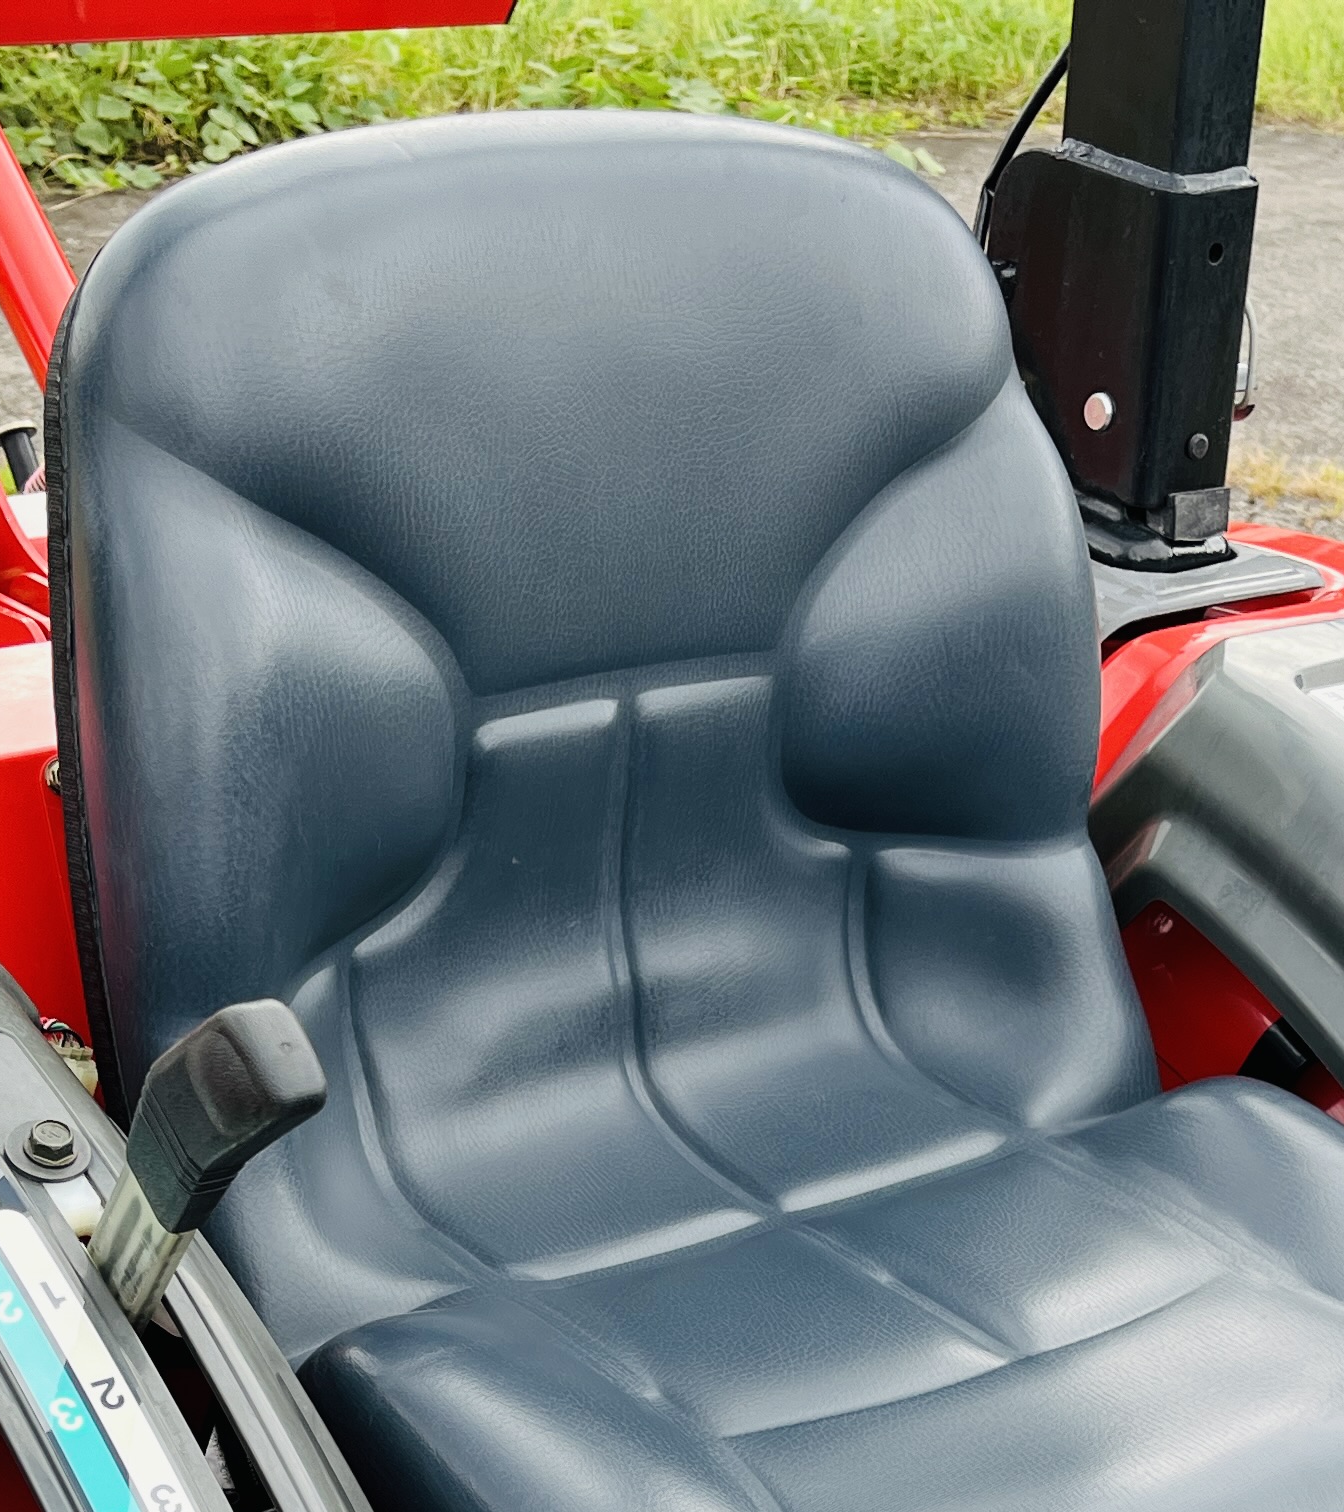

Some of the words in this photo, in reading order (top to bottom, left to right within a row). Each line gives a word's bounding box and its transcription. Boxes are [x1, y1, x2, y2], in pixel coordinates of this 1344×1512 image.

[37, 1282, 69, 1309] 1
[89, 1376, 125, 1411] 2
[50, 1397, 84, 1432] 3
